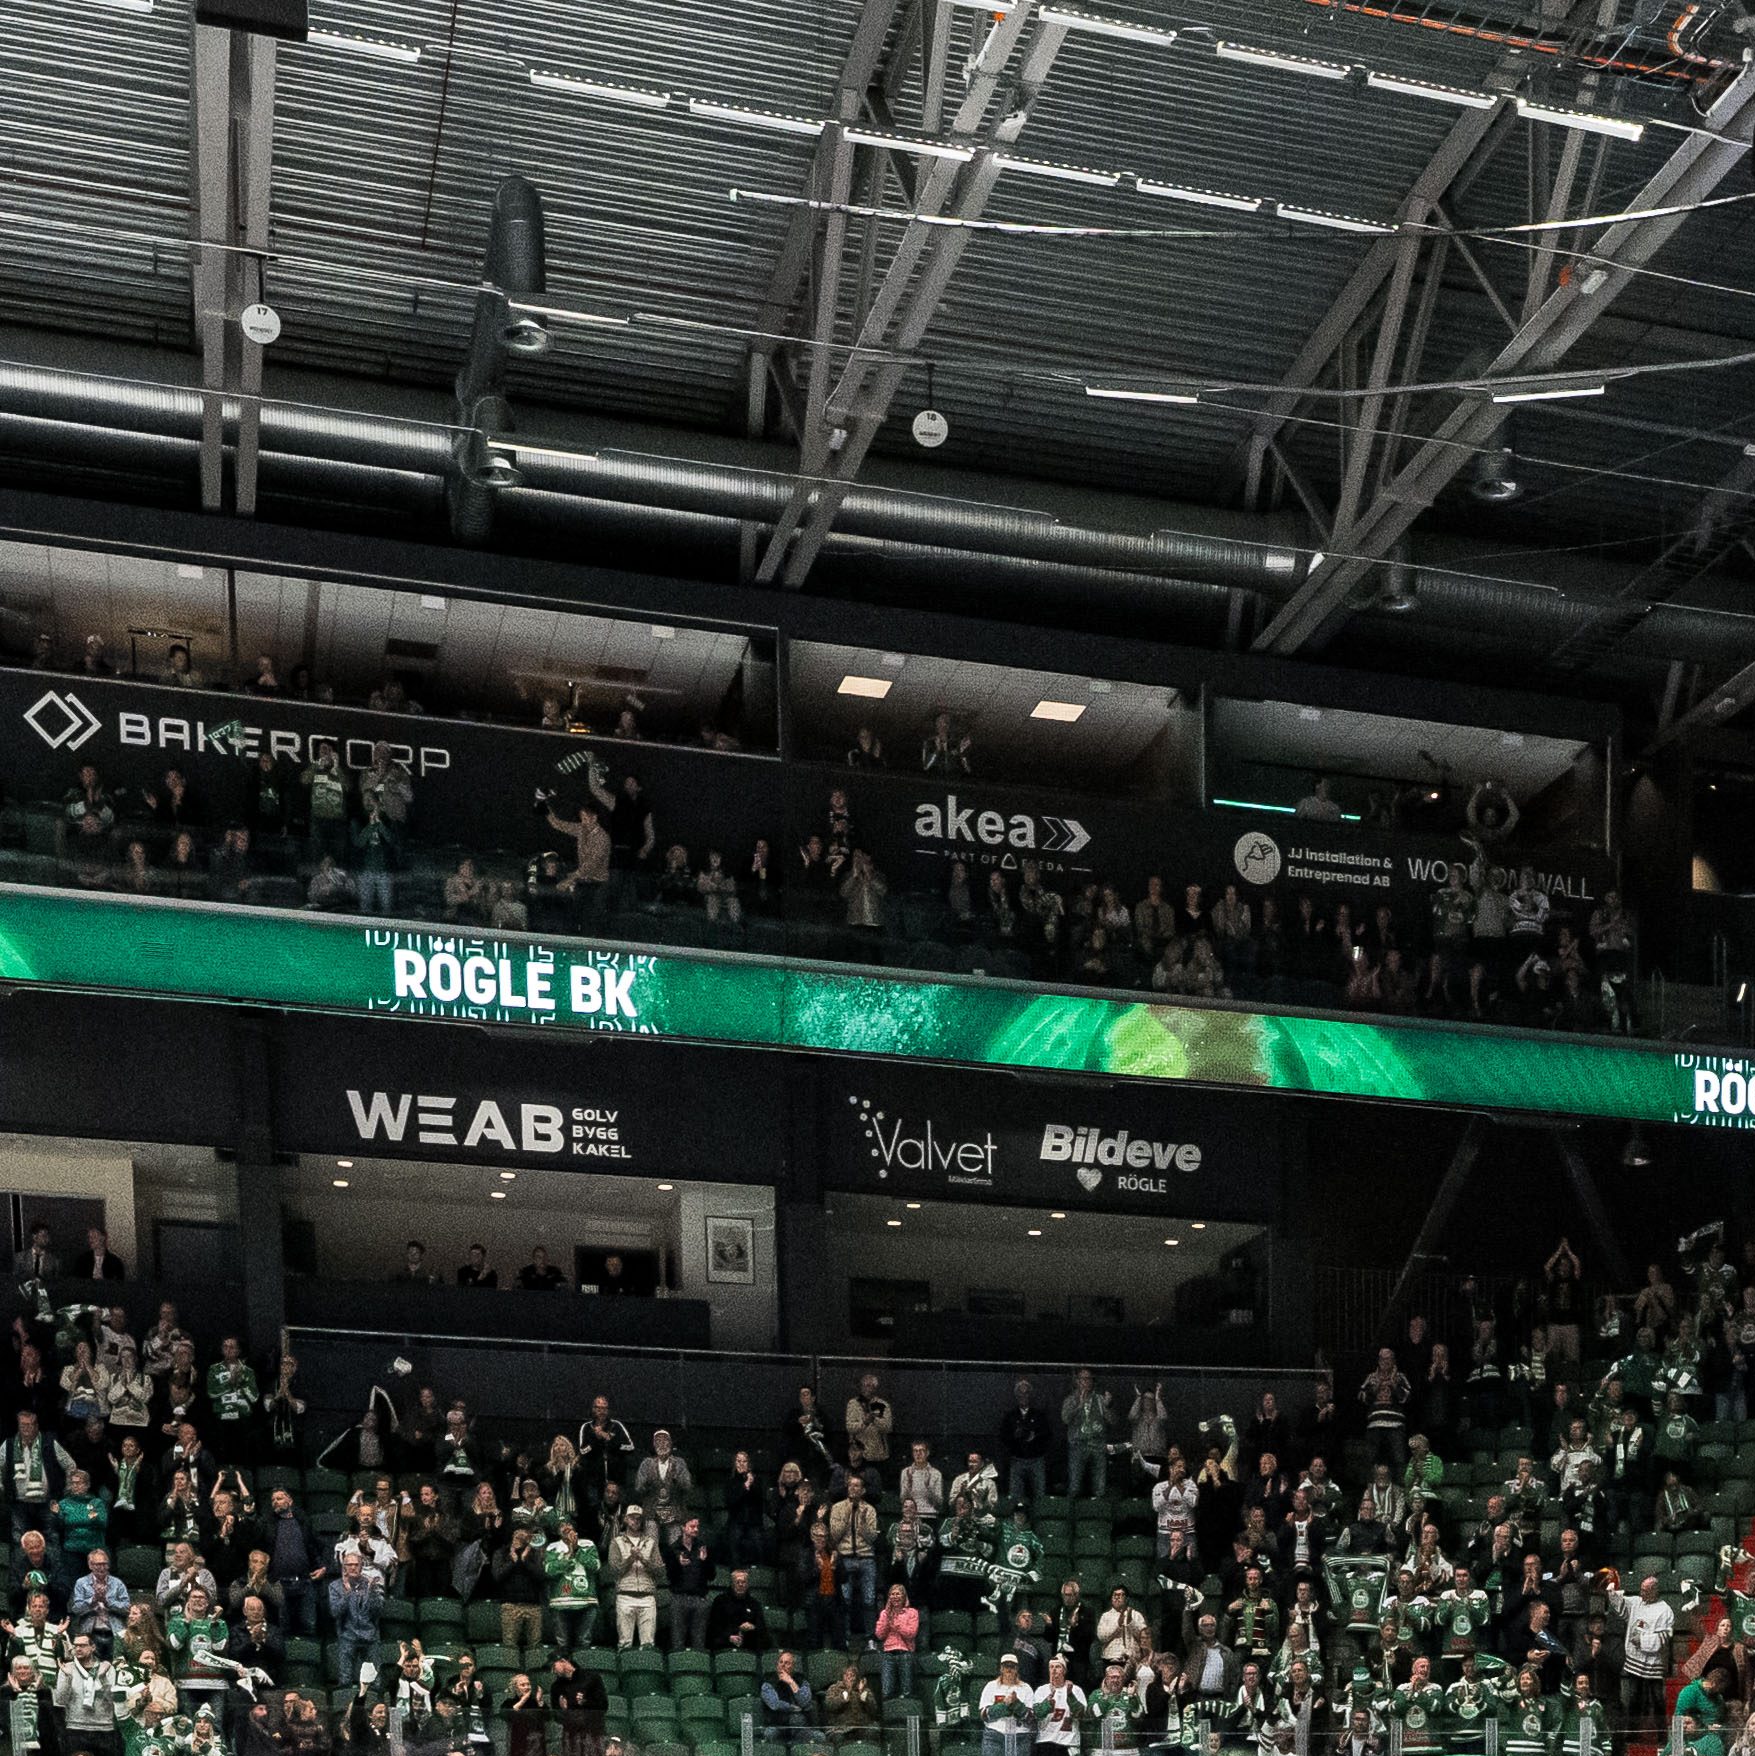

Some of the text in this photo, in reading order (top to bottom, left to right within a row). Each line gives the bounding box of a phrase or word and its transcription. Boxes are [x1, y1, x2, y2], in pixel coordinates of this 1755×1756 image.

[914, 794, 1036, 848] akea
[1022, 858, 1065, 873] FEDA
[1288, 847, 1303, 859] JJ
[1383, 857, 1393, 869] &
[1287, 865, 1391, 887] Entreprenad AB
[394, 941, 555, 1011] RÖGLE
[570, 965, 638, 1018] BK
[346, 1090, 566, 1153] WEAB
[572, 1107, 619, 1123] GOLV
[572, 1125, 619, 1141] BYGG
[572, 1142, 632, 1159] KAKEL
[873, 1117, 998, 1174] Valvet
[1039, 1123, 1202, 1172] Bildeve
[1117, 1175, 1168, 1194] RÖGLE
